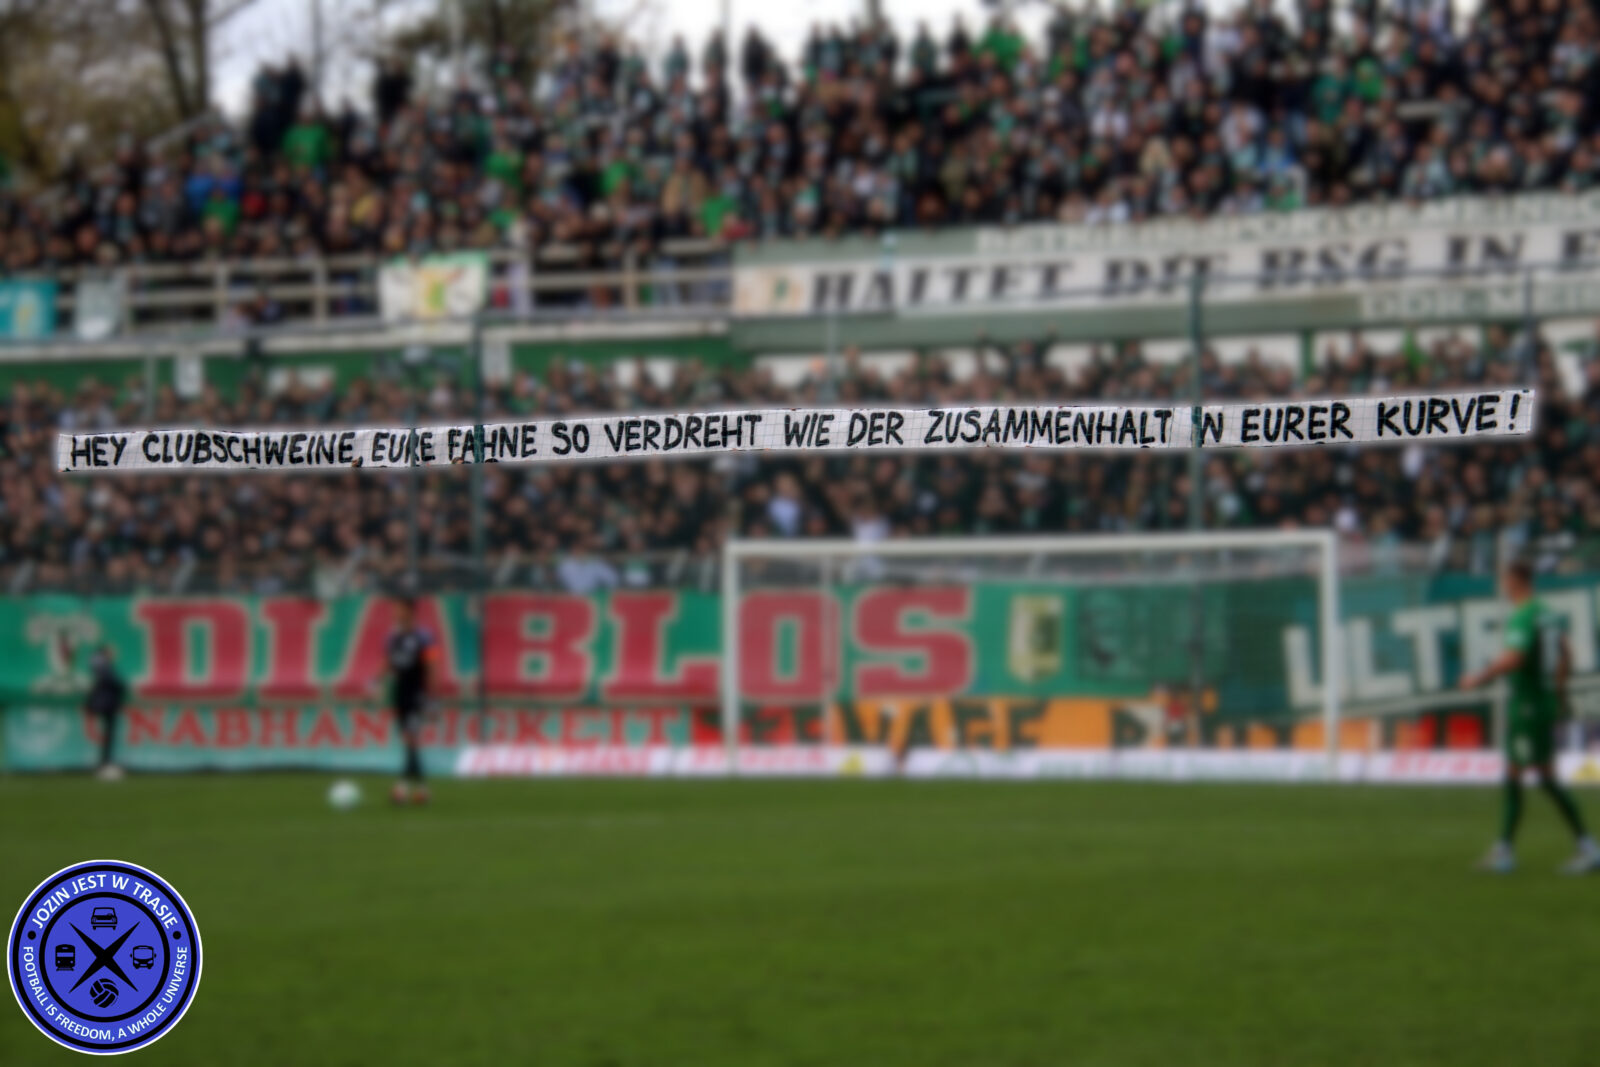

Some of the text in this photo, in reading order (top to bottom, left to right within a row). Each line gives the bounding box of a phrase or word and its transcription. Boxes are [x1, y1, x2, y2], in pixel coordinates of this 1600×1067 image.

[70, 433, 127, 468] HEY
[371, 431, 436, 466] EURE
[448, 424, 537, 460] FAHNE
[552, 421, 590, 455] SO
[604, 414, 762, 452] VERDREHT
[784, 411, 834, 447] WIE
[847, 410, 904, 447] DER
[924, 408, 1172, 446] ZUSAMMENHALT
[1190, 411, 1225, 444] N
[1240, 401, 1354, 443] EURER
[133, 588, 974, 702] DIABLOS
